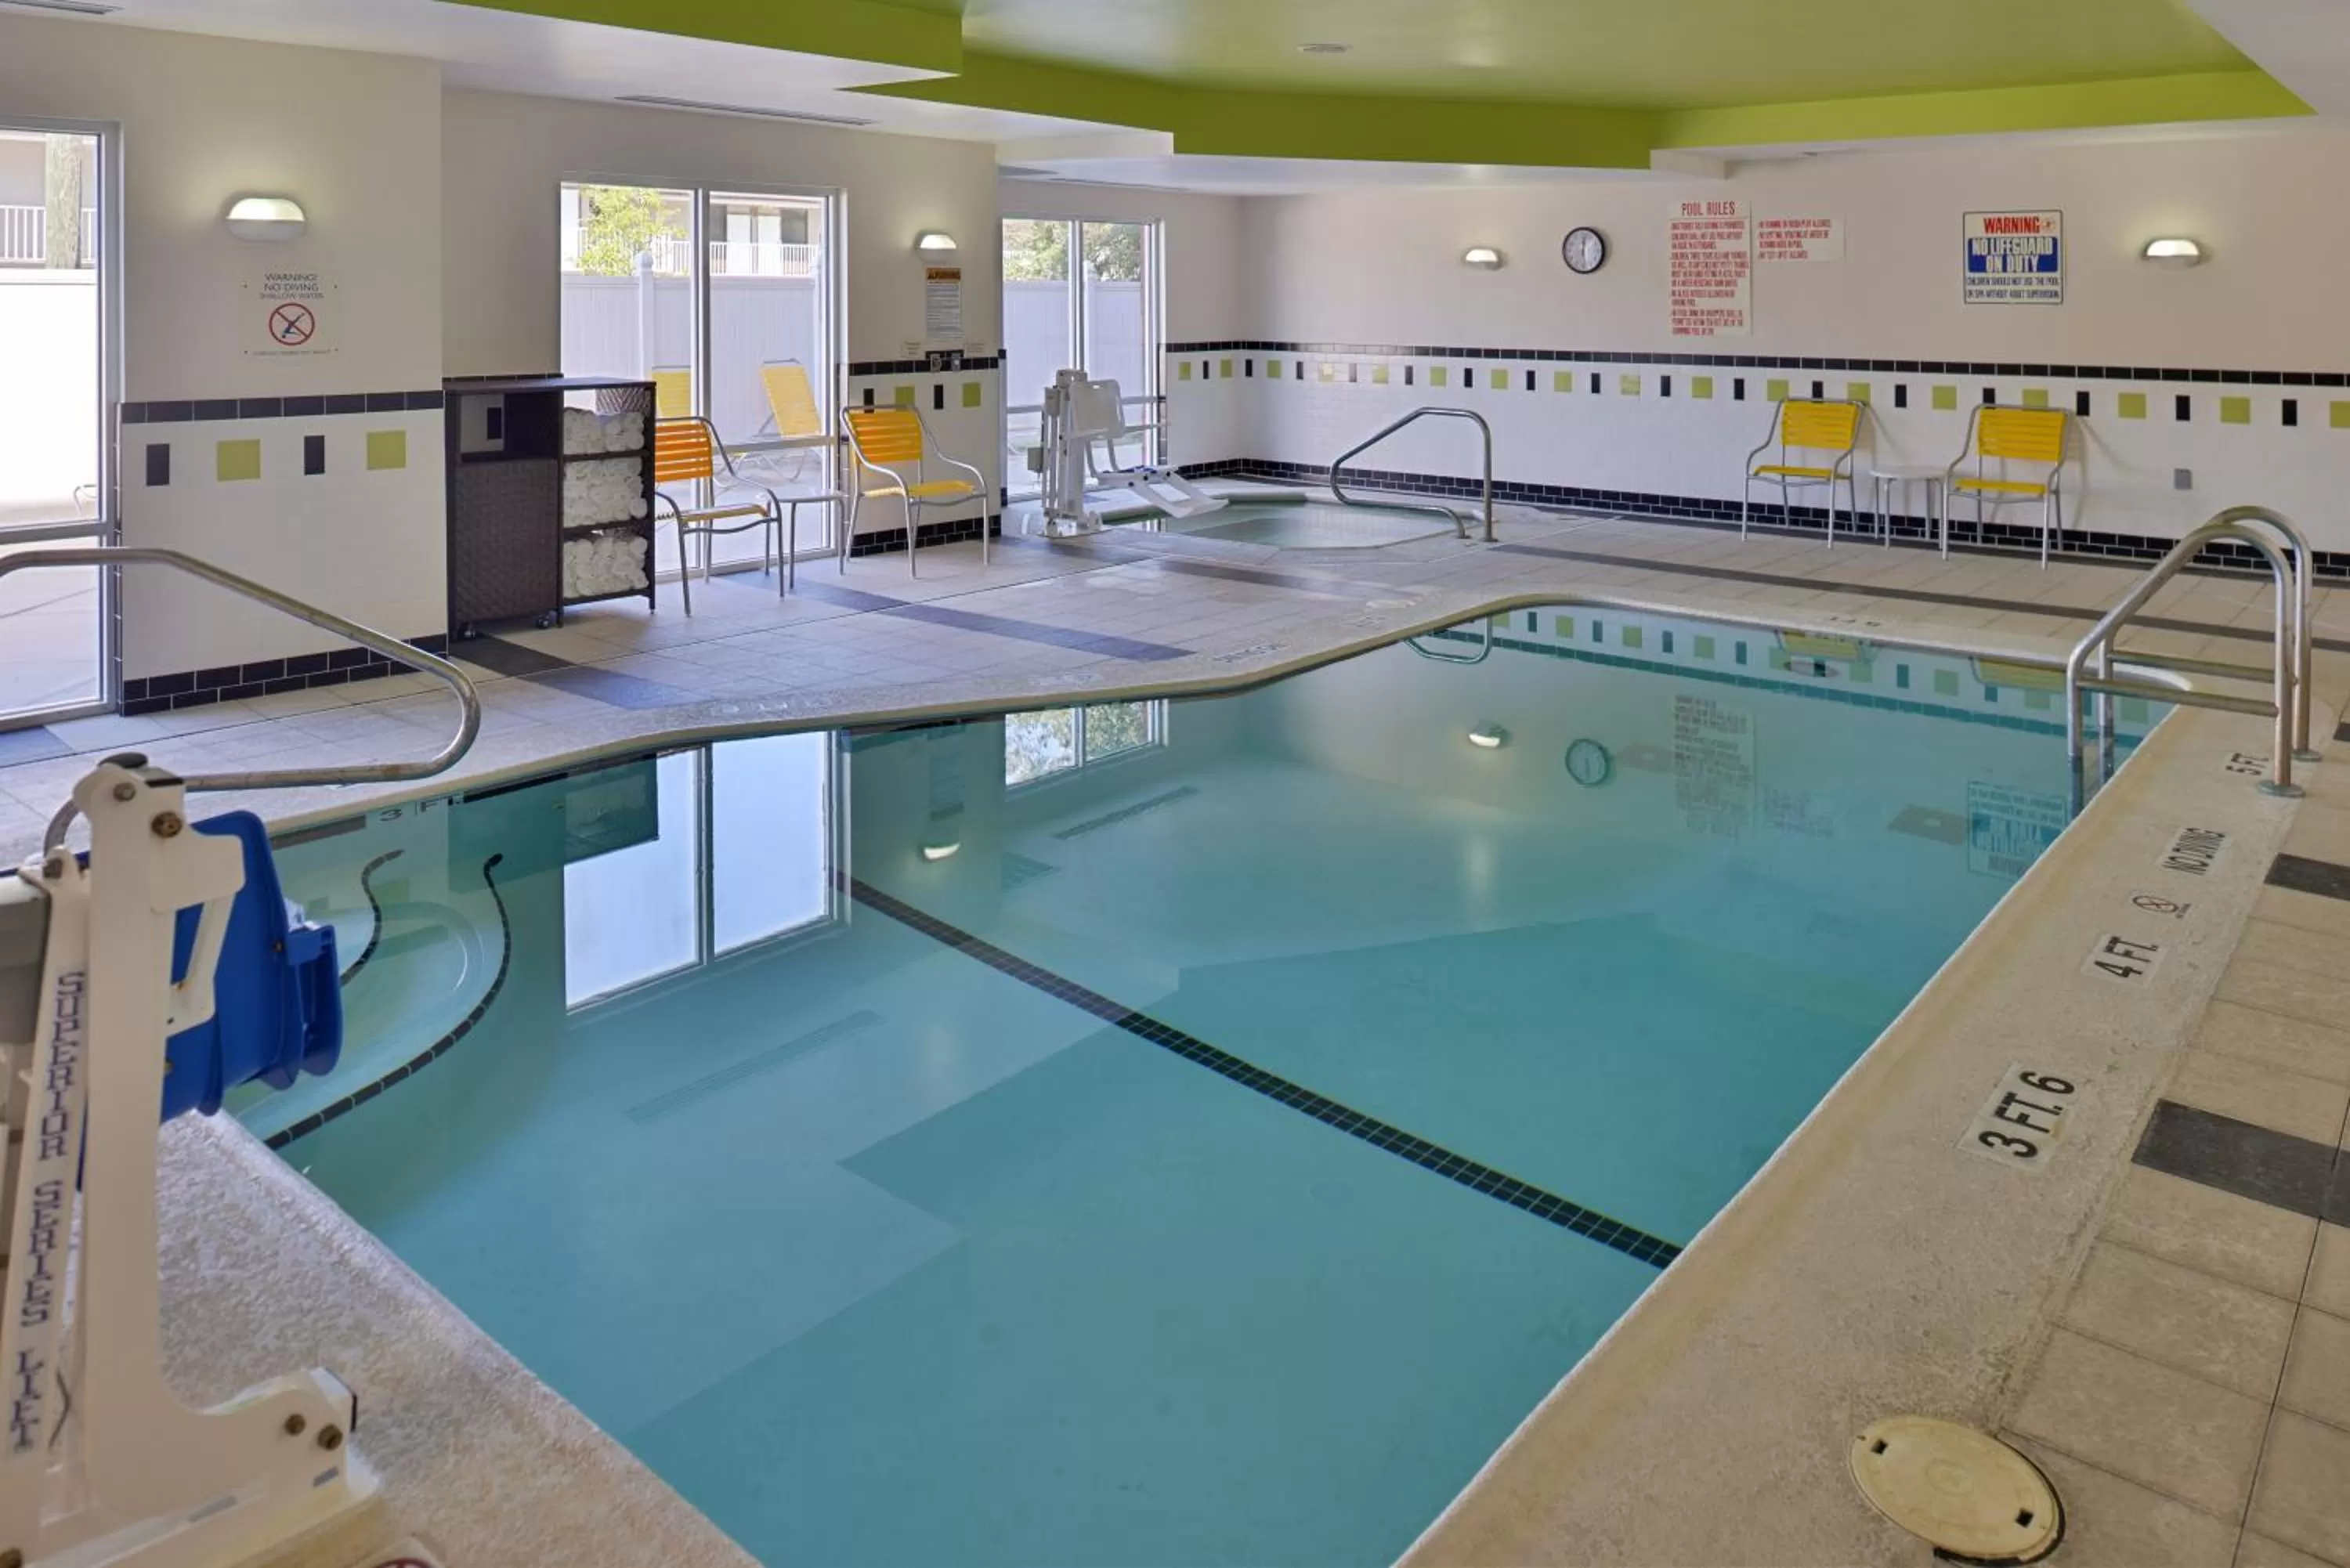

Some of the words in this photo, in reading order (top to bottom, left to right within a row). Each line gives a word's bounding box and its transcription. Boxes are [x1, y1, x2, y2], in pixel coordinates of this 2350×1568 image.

[1681, 202, 1705, 216] POOL
[1707, 201, 1736, 216] RULES
[1983, 215, 2041, 234] WARNING
[1972, 237, 1987, 255] NO
[1990, 237, 2052, 255] LIFEGUARD
[1986, 255, 2003, 273] ON
[2006, 254, 2038, 273] DUTY
[263, 282, 282, 292] NO
[284, 282, 320, 292] DIVING
[2094, 960, 2144, 978] 4
[38, 970, 86, 1162] SUPERIOR
[1978, 1130, 2038, 1158] 3
[2019, 1071, 2075, 1095] 6
[20, 1180, 64, 1328] SERIES
[10, 1346, 45, 1454] LIFT
